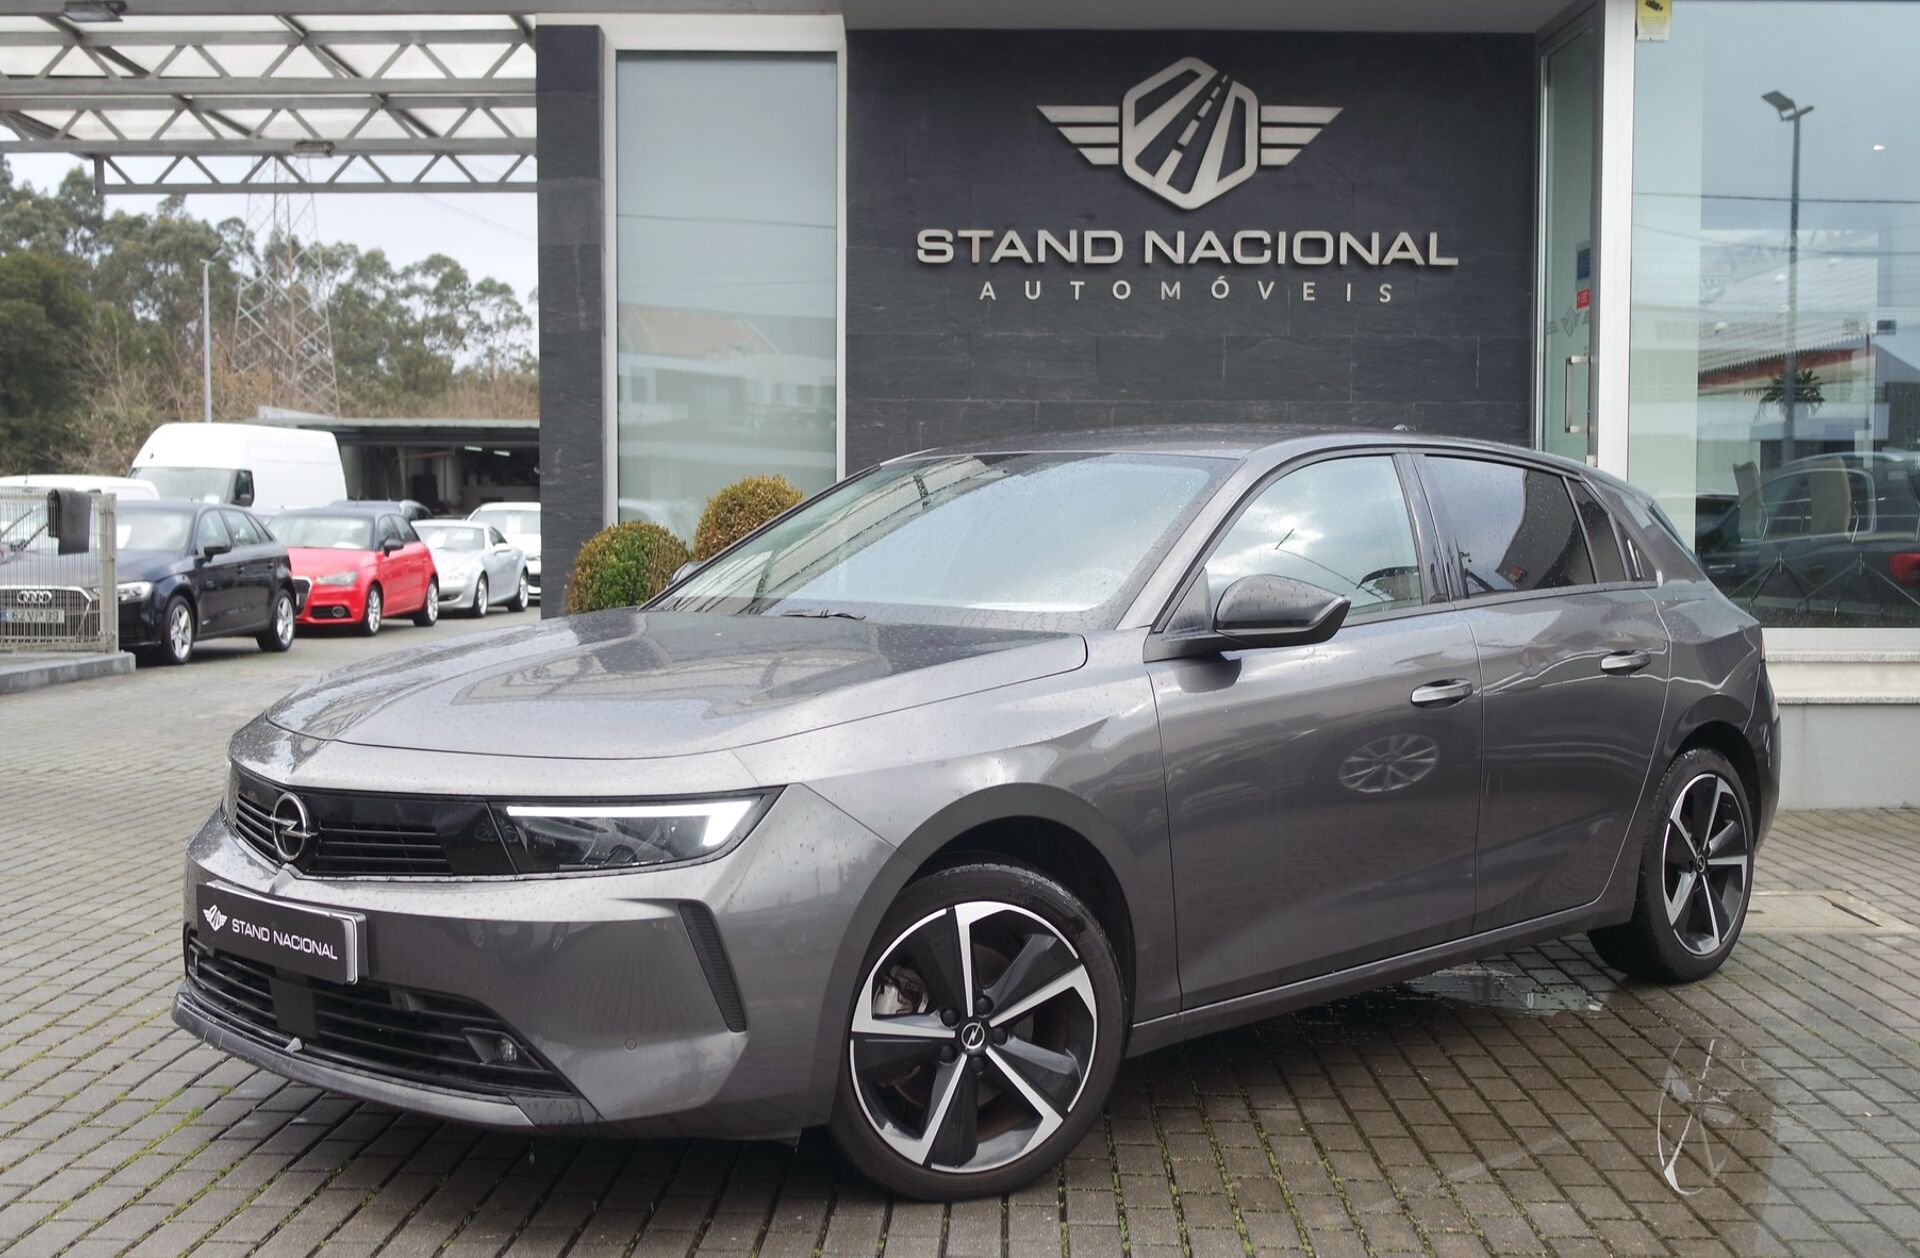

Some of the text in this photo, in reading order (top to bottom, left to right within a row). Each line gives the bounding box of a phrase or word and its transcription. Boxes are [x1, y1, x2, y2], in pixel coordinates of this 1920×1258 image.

[917, 229, 1460, 266] STAND NACIONAL
[979, 275, 1393, 303] AUTOMÓVEIS
[231, 918, 338, 960] STAND NACIONAL
